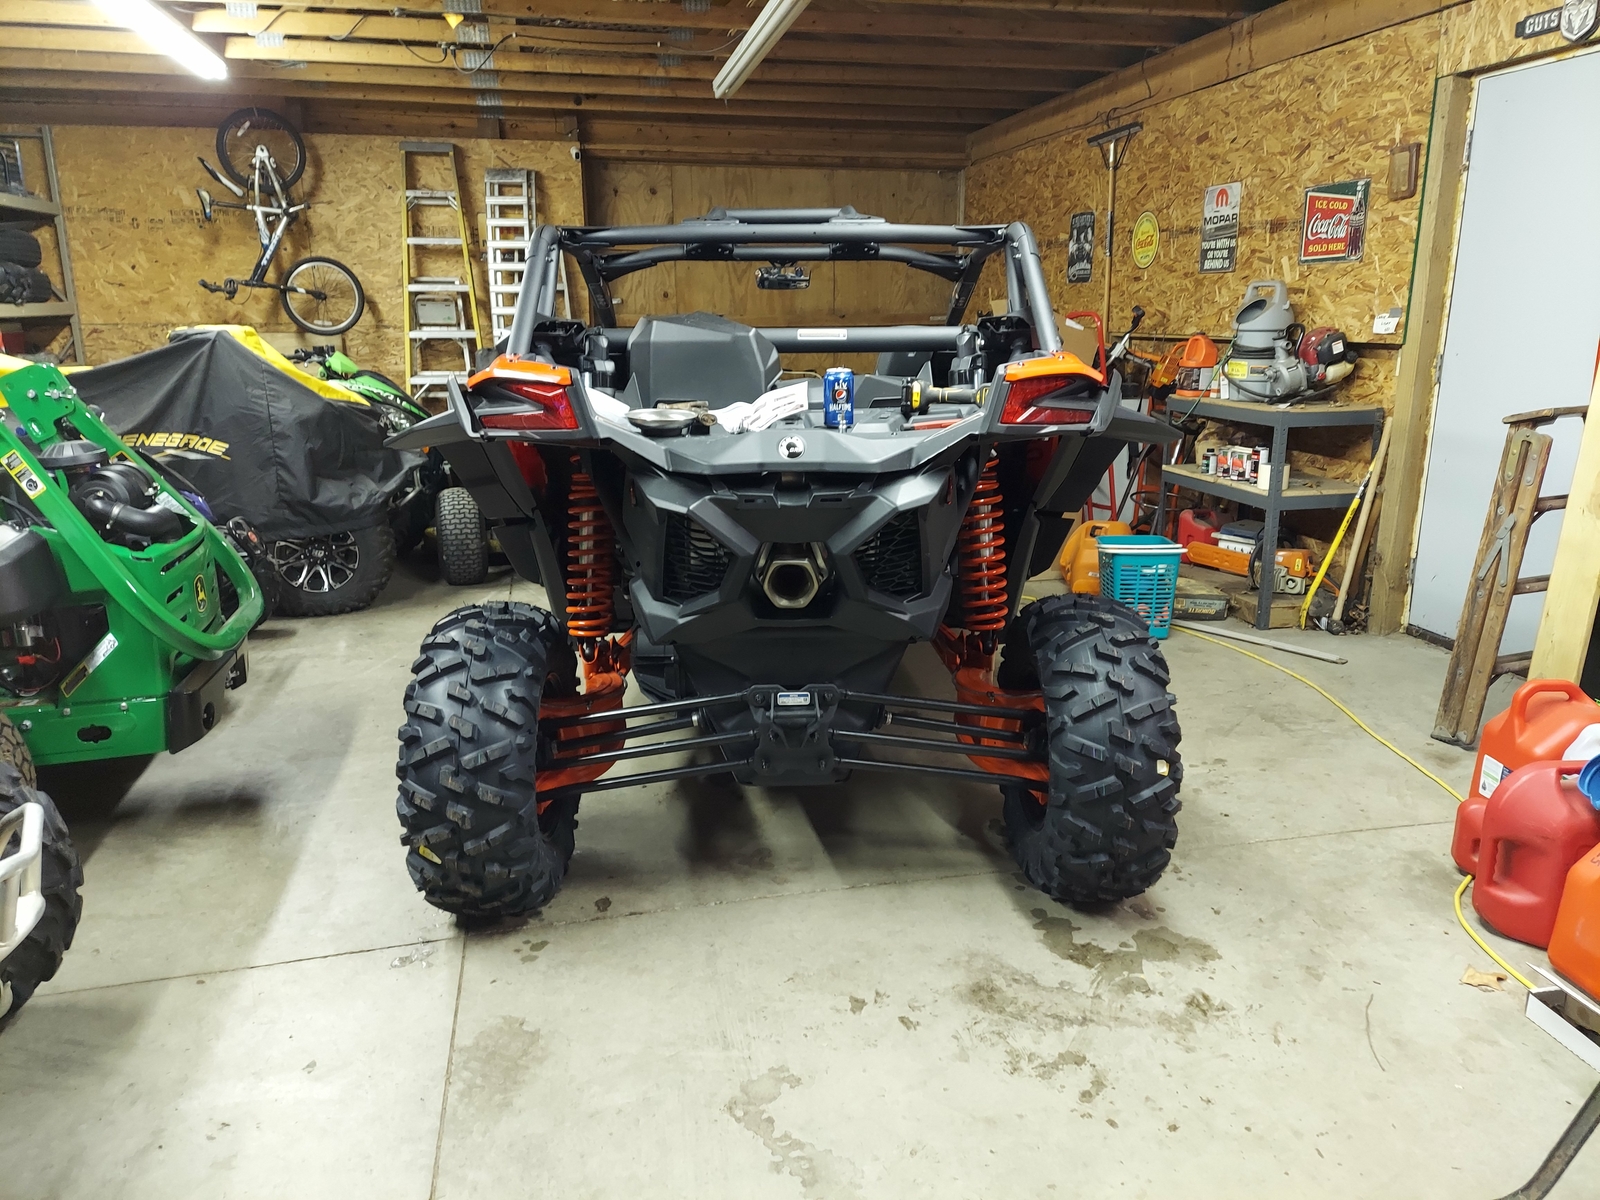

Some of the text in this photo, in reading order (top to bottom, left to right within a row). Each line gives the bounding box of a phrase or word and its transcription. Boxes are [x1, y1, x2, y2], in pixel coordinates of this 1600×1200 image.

[1525, 11, 1559, 34] GUTS
[1315, 199, 1349, 210] ICE COLD
[1203, 213, 1238, 226] MOPAR
[1216, 238, 1231, 249] WITH
[1230, 238, 1237, 247] US
[1308, 241, 1346, 253] SOLD HERE
[1207, 250, 1214, 259] OR
[1203, 259, 1230, 270] BEHIND US
[117, 432, 229, 455] ENEGADE
